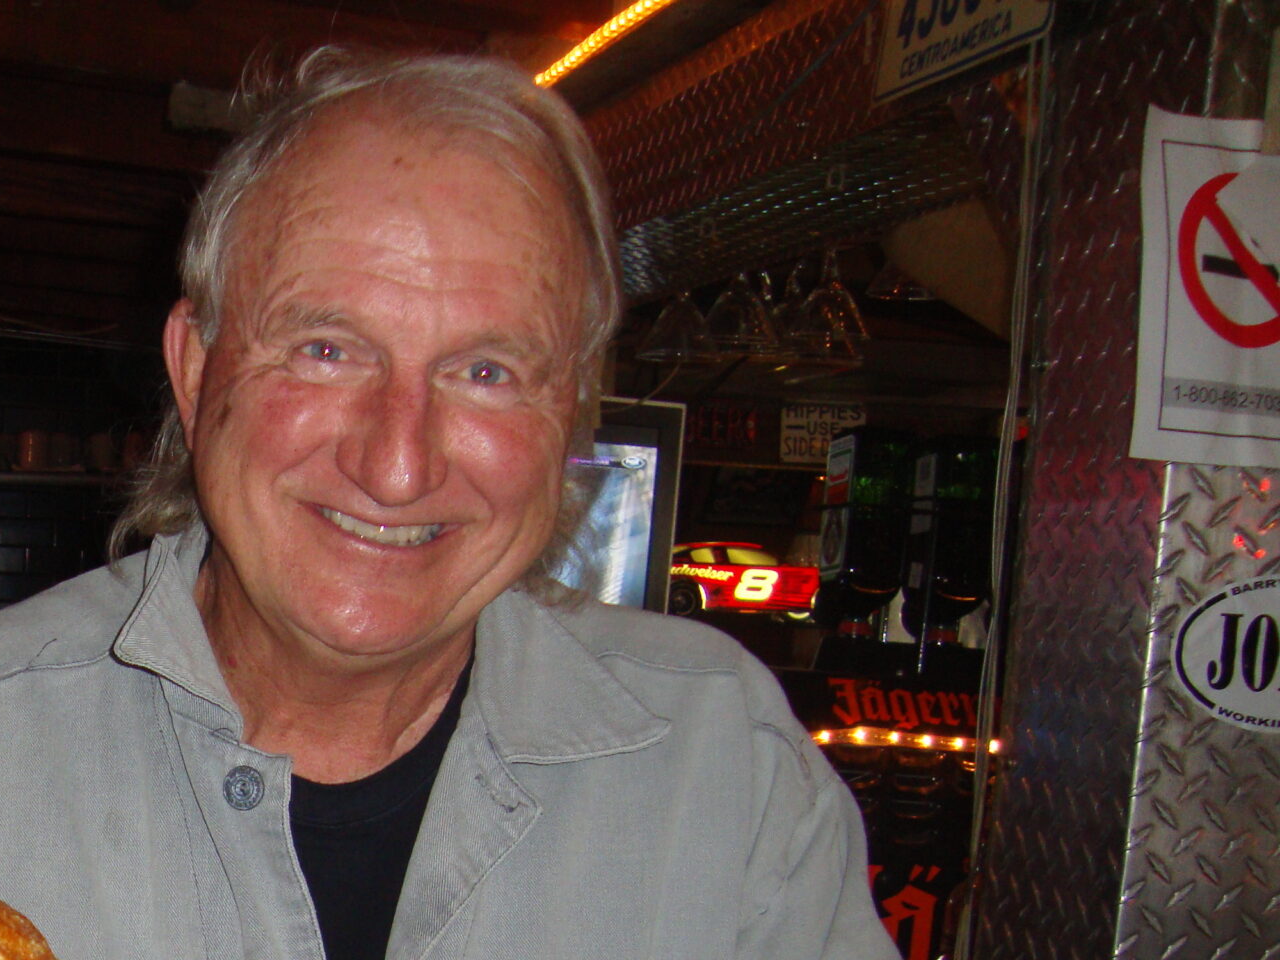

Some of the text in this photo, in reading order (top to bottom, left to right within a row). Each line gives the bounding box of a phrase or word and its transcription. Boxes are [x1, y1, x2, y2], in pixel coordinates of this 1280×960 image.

[900, 11, 1012, 79] CENTROAMERICA
[784, 404, 862, 421] HIPPIES
[807, 420, 839, 436] USE
[783, 436, 817, 457] SIDE
[670, 564, 779, 602] udweiser 8
[1231, 579, 1280, 596] BARR
[1207, 612, 1280, 693] JO
